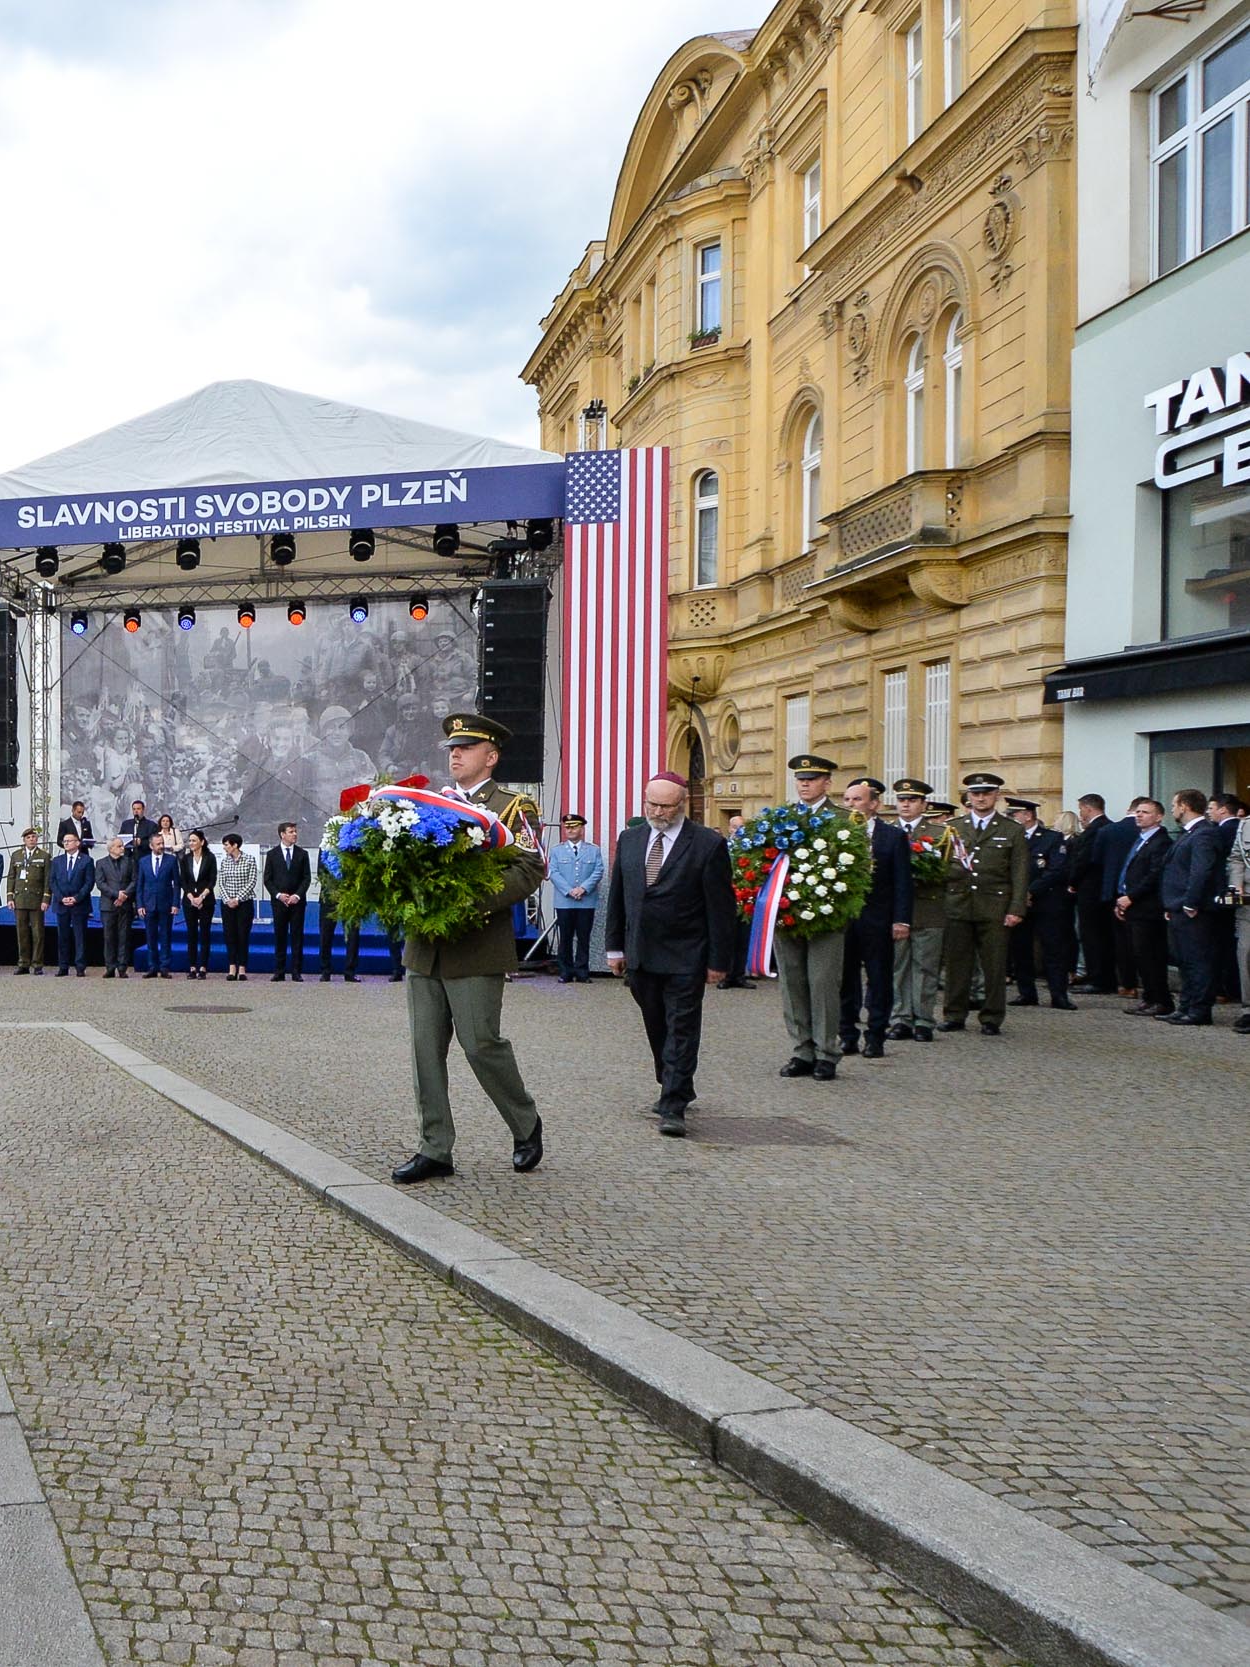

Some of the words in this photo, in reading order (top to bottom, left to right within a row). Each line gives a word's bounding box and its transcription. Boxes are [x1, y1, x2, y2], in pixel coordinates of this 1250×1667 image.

[17, 496, 186, 529] SLAVNOSTI
[194, 485, 352, 518] SVOBODY
[361, 471, 468, 508] PLZEŇ
[118, 522, 210, 540] LIBERATION
[214, 518, 290, 534] FESTIVAL
[293, 513, 351, 529] PILSEN
